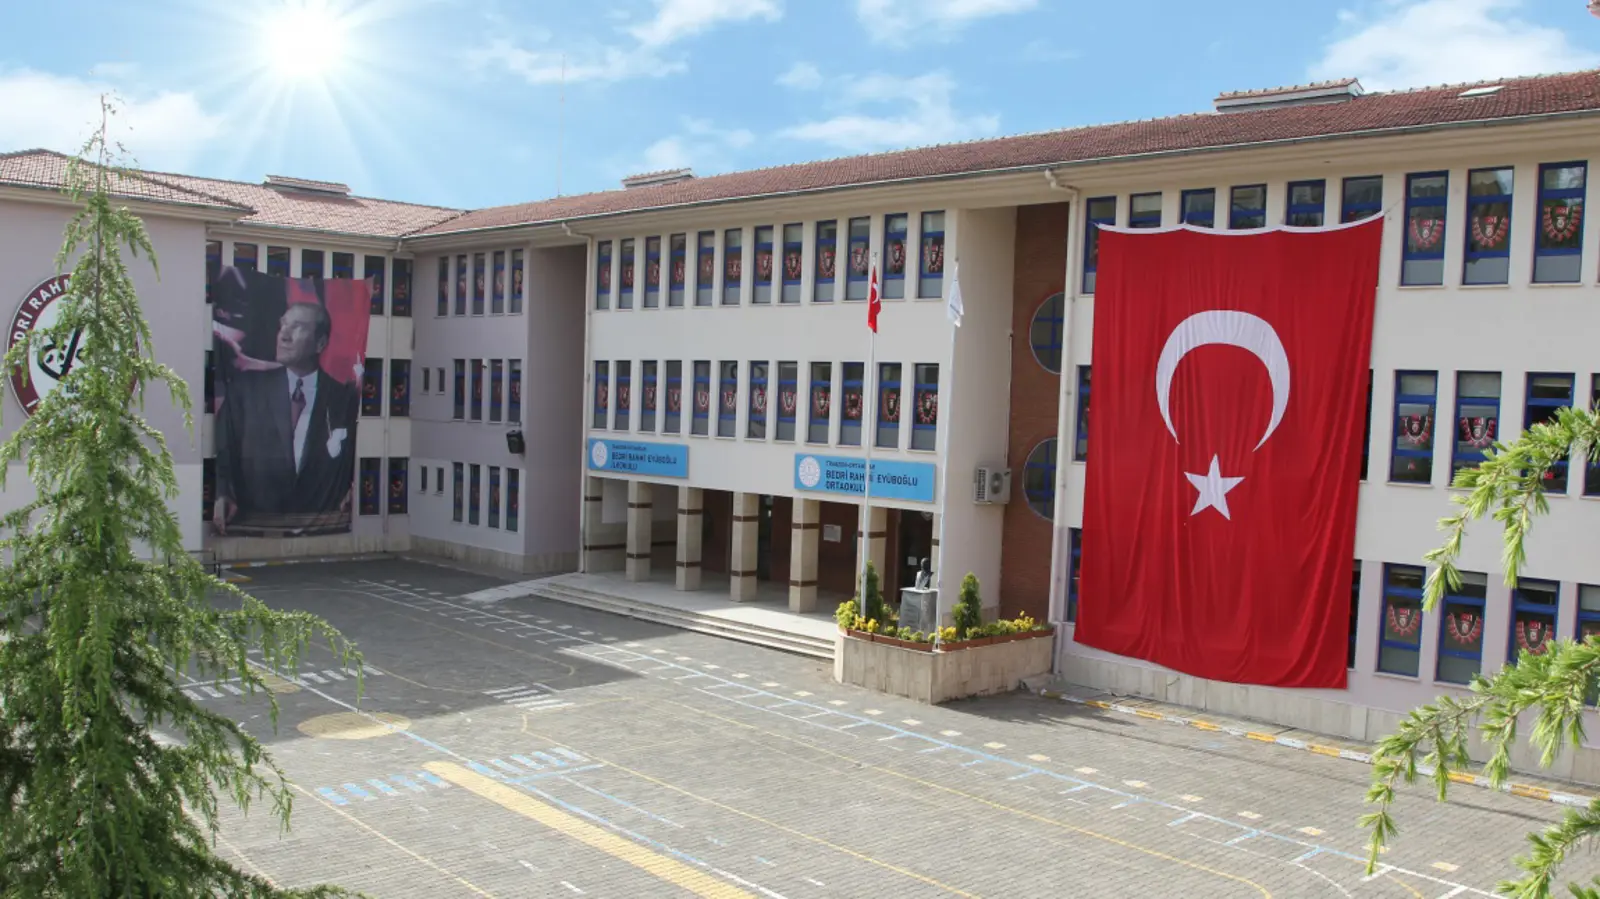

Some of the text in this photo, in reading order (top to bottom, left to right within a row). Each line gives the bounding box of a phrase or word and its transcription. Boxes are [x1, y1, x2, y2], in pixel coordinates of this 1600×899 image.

[826, 469, 848, 481] BEDRİ
[877, 473, 918, 487] EYÜBOĞLU
[825, 480, 867, 493] ORTAOKUL
